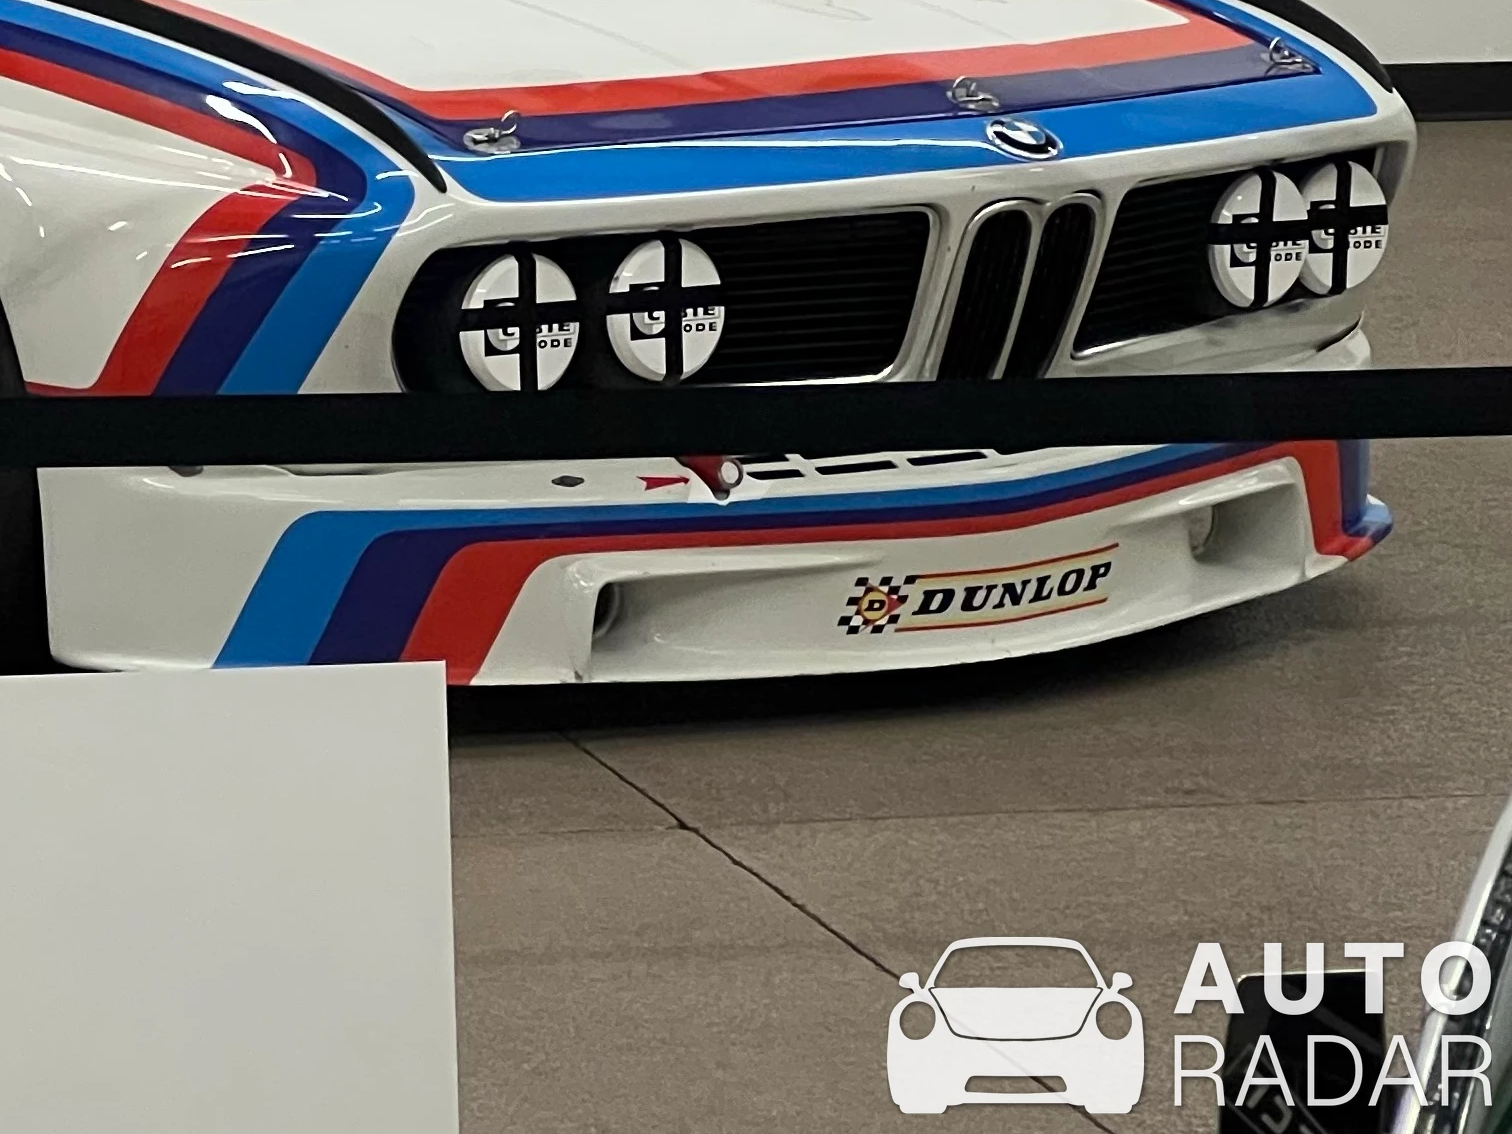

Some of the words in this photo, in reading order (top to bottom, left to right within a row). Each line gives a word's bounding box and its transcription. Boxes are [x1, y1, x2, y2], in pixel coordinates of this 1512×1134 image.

[1354, 239, 1383, 250] ODE
[1274, 252, 1303, 262] ODE
[683, 321, 718, 333] ODE
[538, 337, 573, 349] ODE
[911, 561, 1112, 616] DUNLOP
